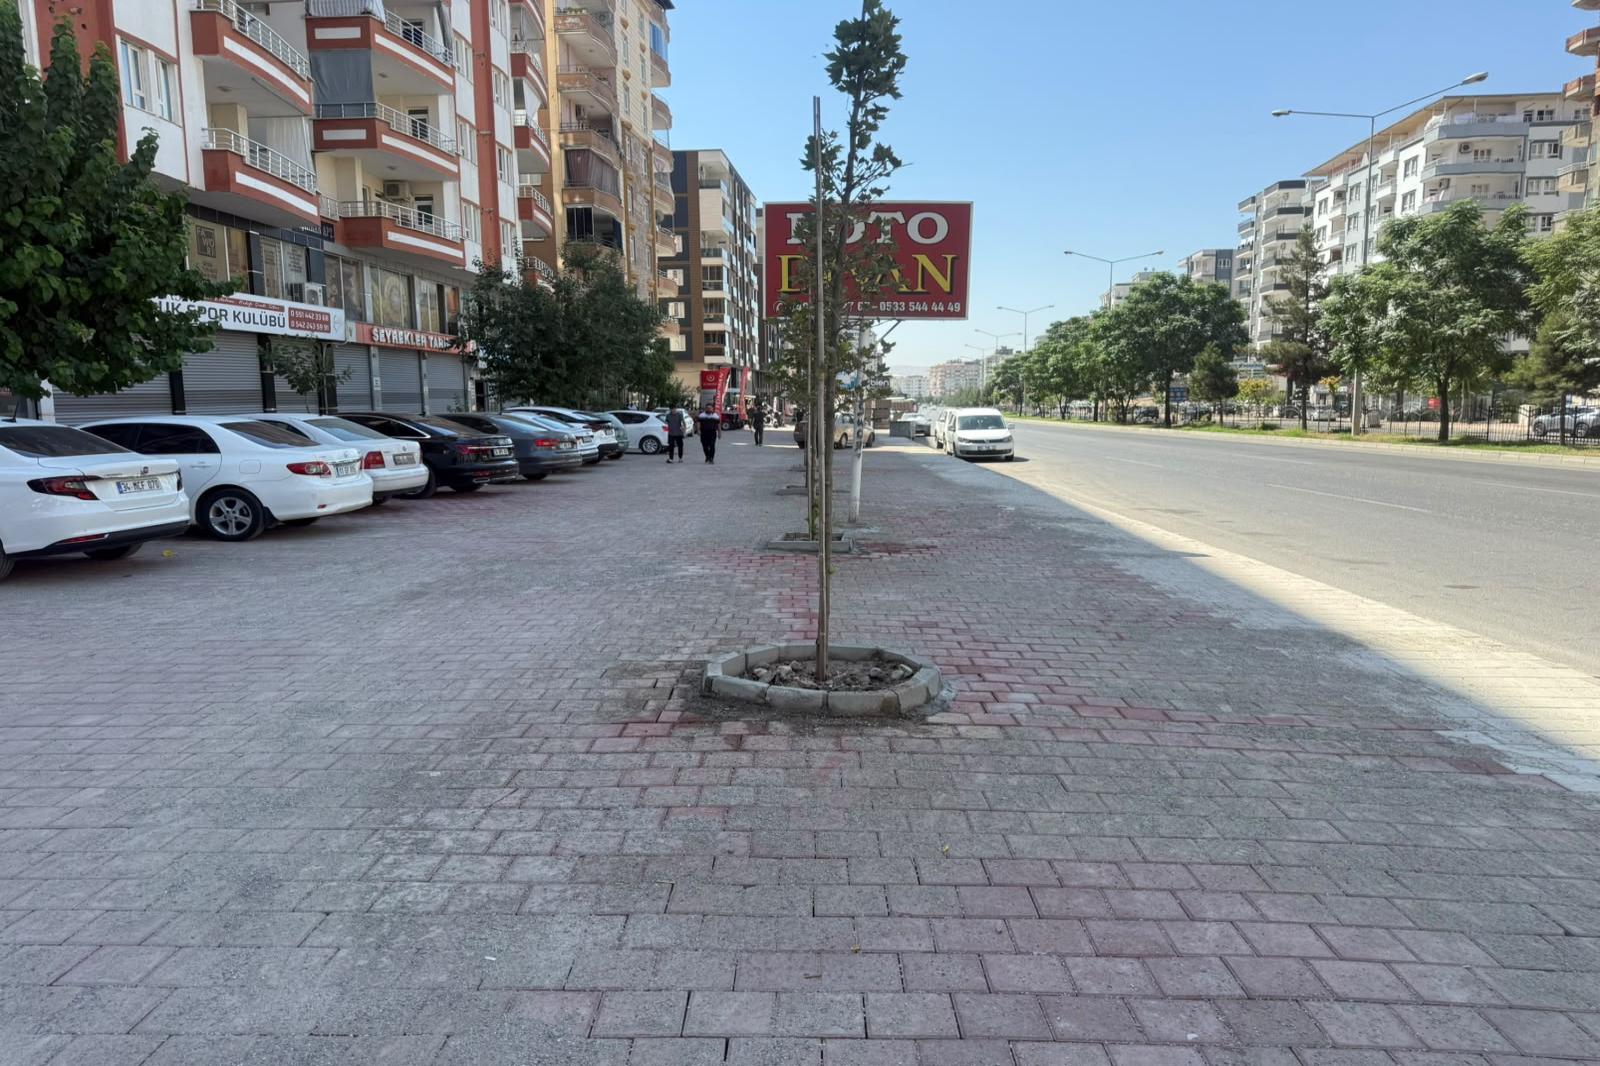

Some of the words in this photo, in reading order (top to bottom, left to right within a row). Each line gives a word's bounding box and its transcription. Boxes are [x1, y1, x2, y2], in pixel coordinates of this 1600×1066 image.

[879, 302, 905, 312] 0533
[908, 302, 928, 312] 544
[931, 303, 944, 312] 44
[947, 303, 961, 313] 49
[233, 309, 286, 329] KULÜBÜ
[305, 311, 315, 320] 442
[372, 327, 426, 347] SEYREKLER
